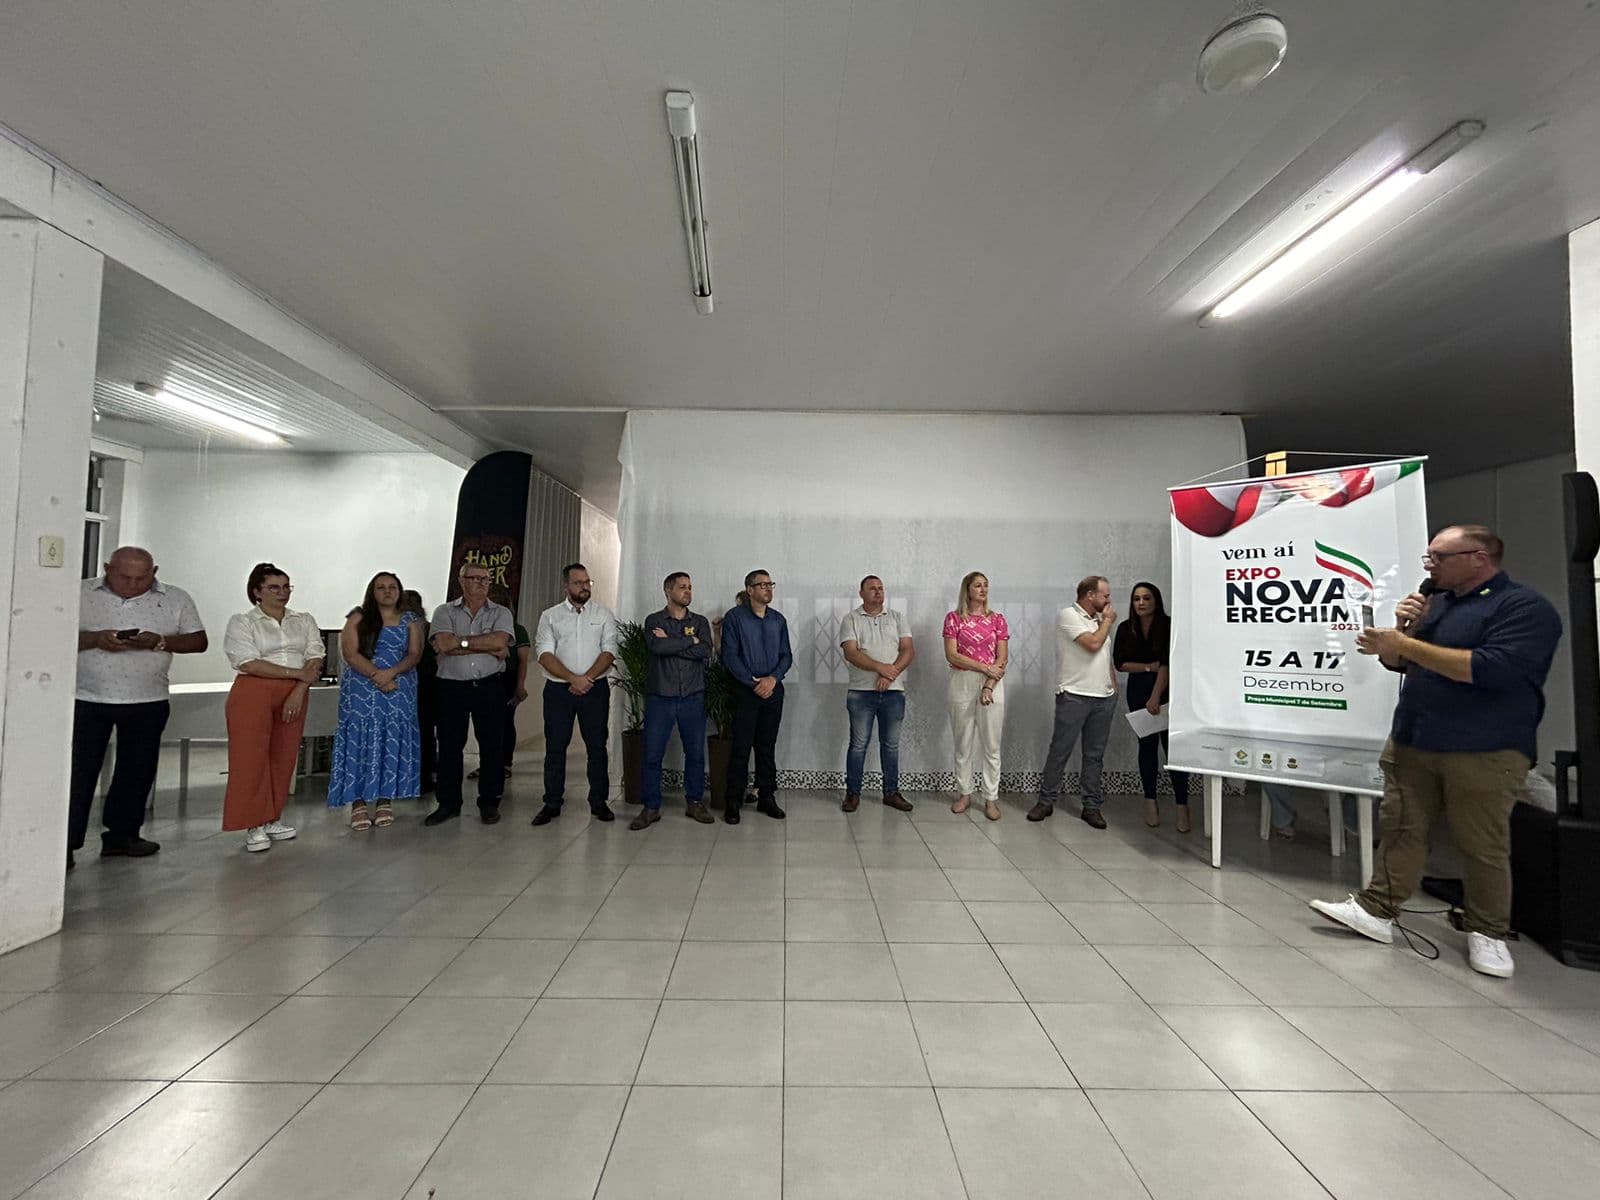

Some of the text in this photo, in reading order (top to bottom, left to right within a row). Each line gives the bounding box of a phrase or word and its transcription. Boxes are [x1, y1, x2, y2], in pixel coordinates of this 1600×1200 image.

[464, 545, 512, 567] HAND
[1223, 541, 1295, 561] vem aí
[1226, 567, 1281, 581] EXPO
[1226, 578, 1346, 606] NOVA
[1331, 623, 1360, 631] 2023
[1245, 650, 1346, 669] 15 A 17
[1243, 676, 1344, 693] Dezembro
